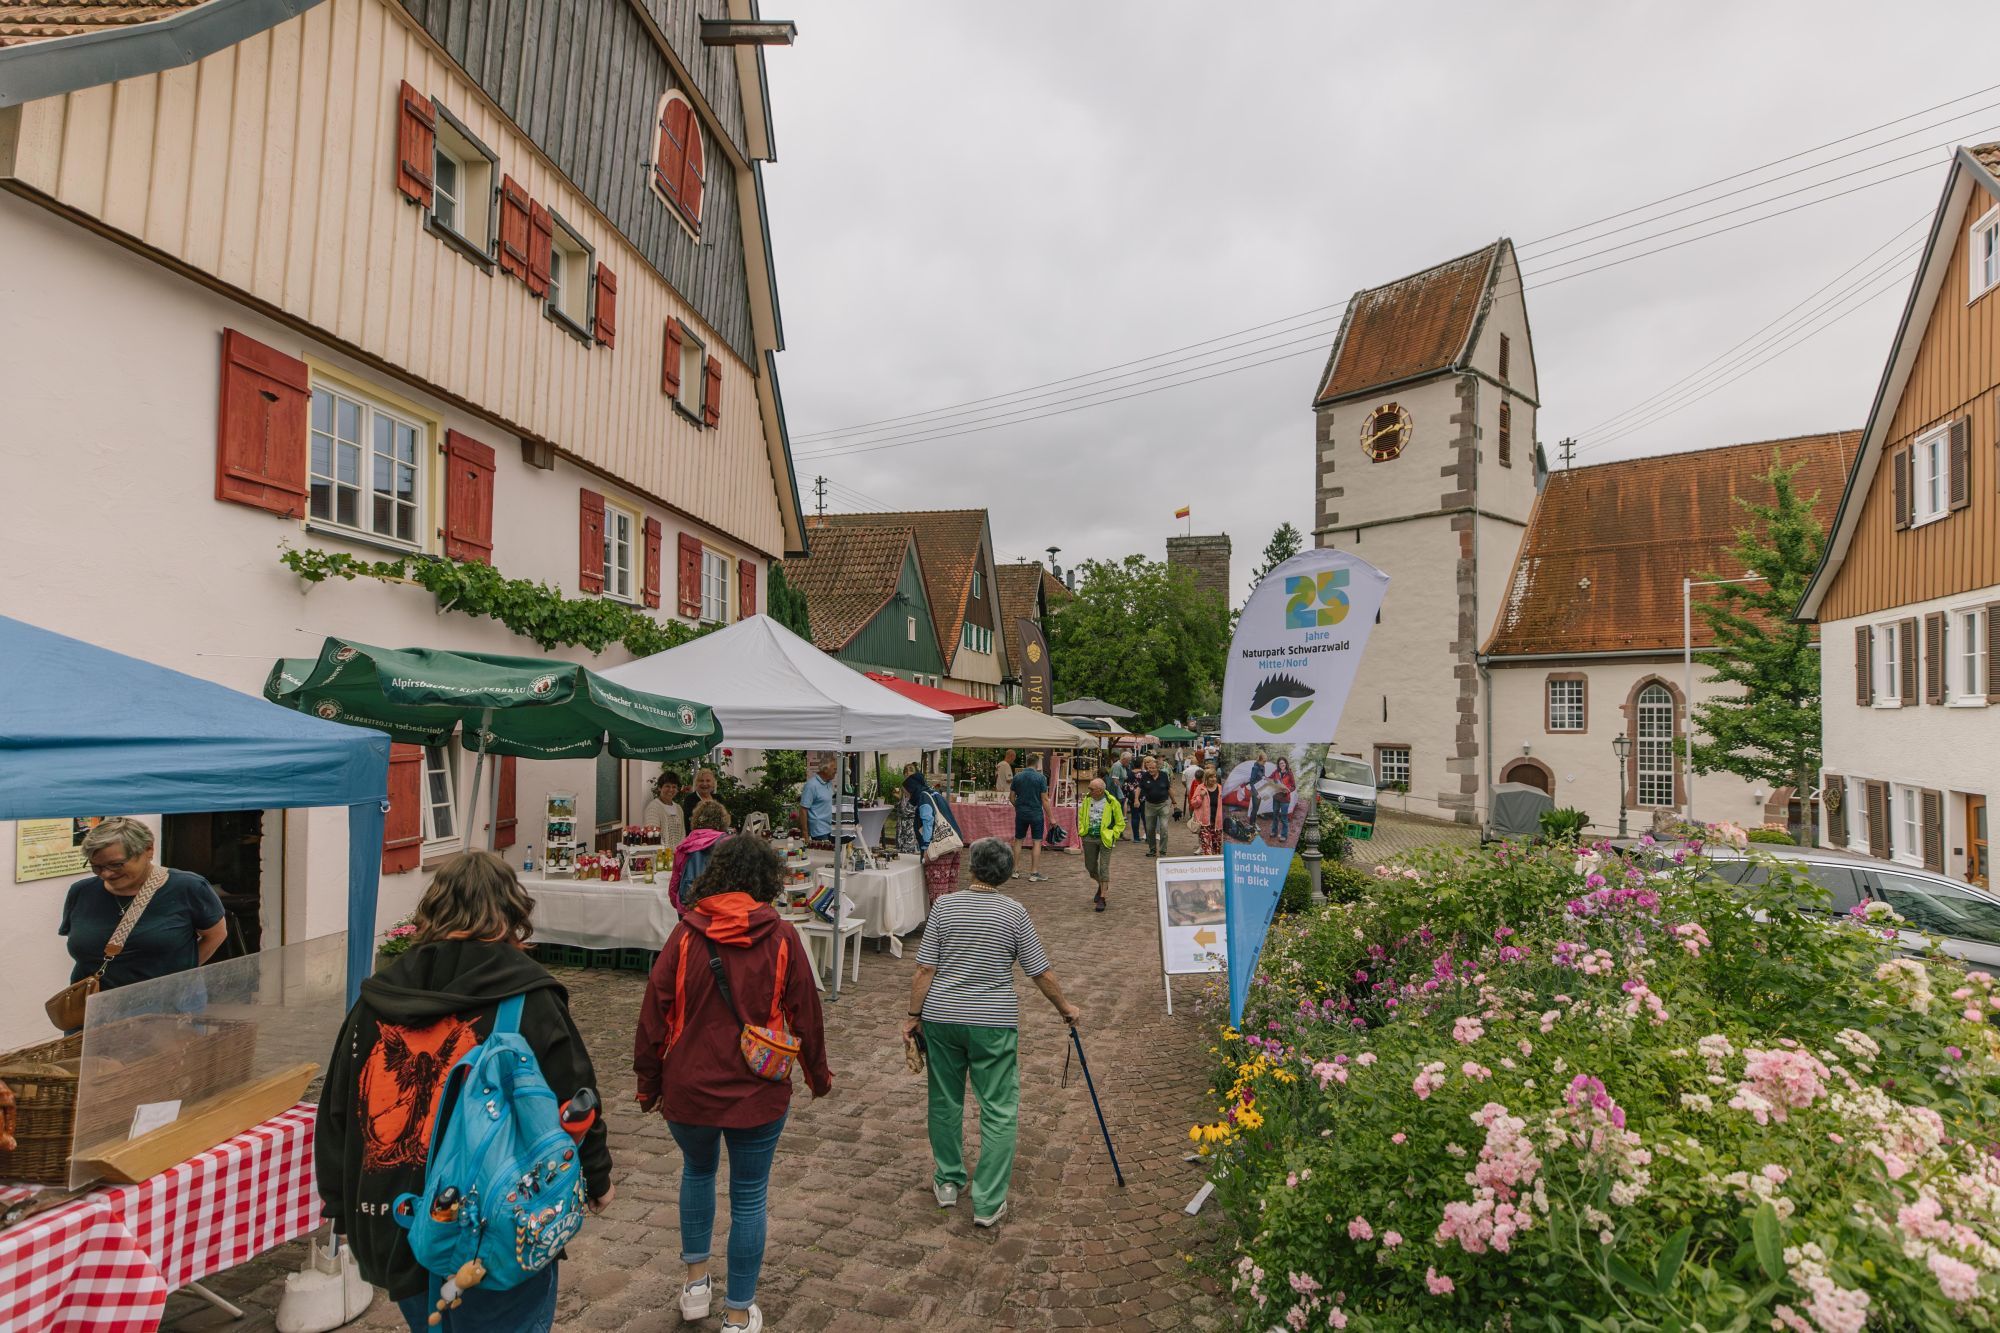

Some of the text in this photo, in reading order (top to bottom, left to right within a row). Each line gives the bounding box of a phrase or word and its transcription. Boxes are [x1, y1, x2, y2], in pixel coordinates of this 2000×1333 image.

[1285, 568, 1350, 630] 25
[1305, 630, 1330, 643] Jahre
[1242, 640, 1350, 659] Naturpark Schwarzwald
[1258, 657, 1308, 669] Mitte/Nord
[391, 677, 456, 691] Alpirsbacher
[1234, 850, 1267, 862] Mensch
[1234, 863, 1279, 876] und Natur
[1247, 875, 1269, 887] Blick
[355, 1202, 390, 1216] EEP
